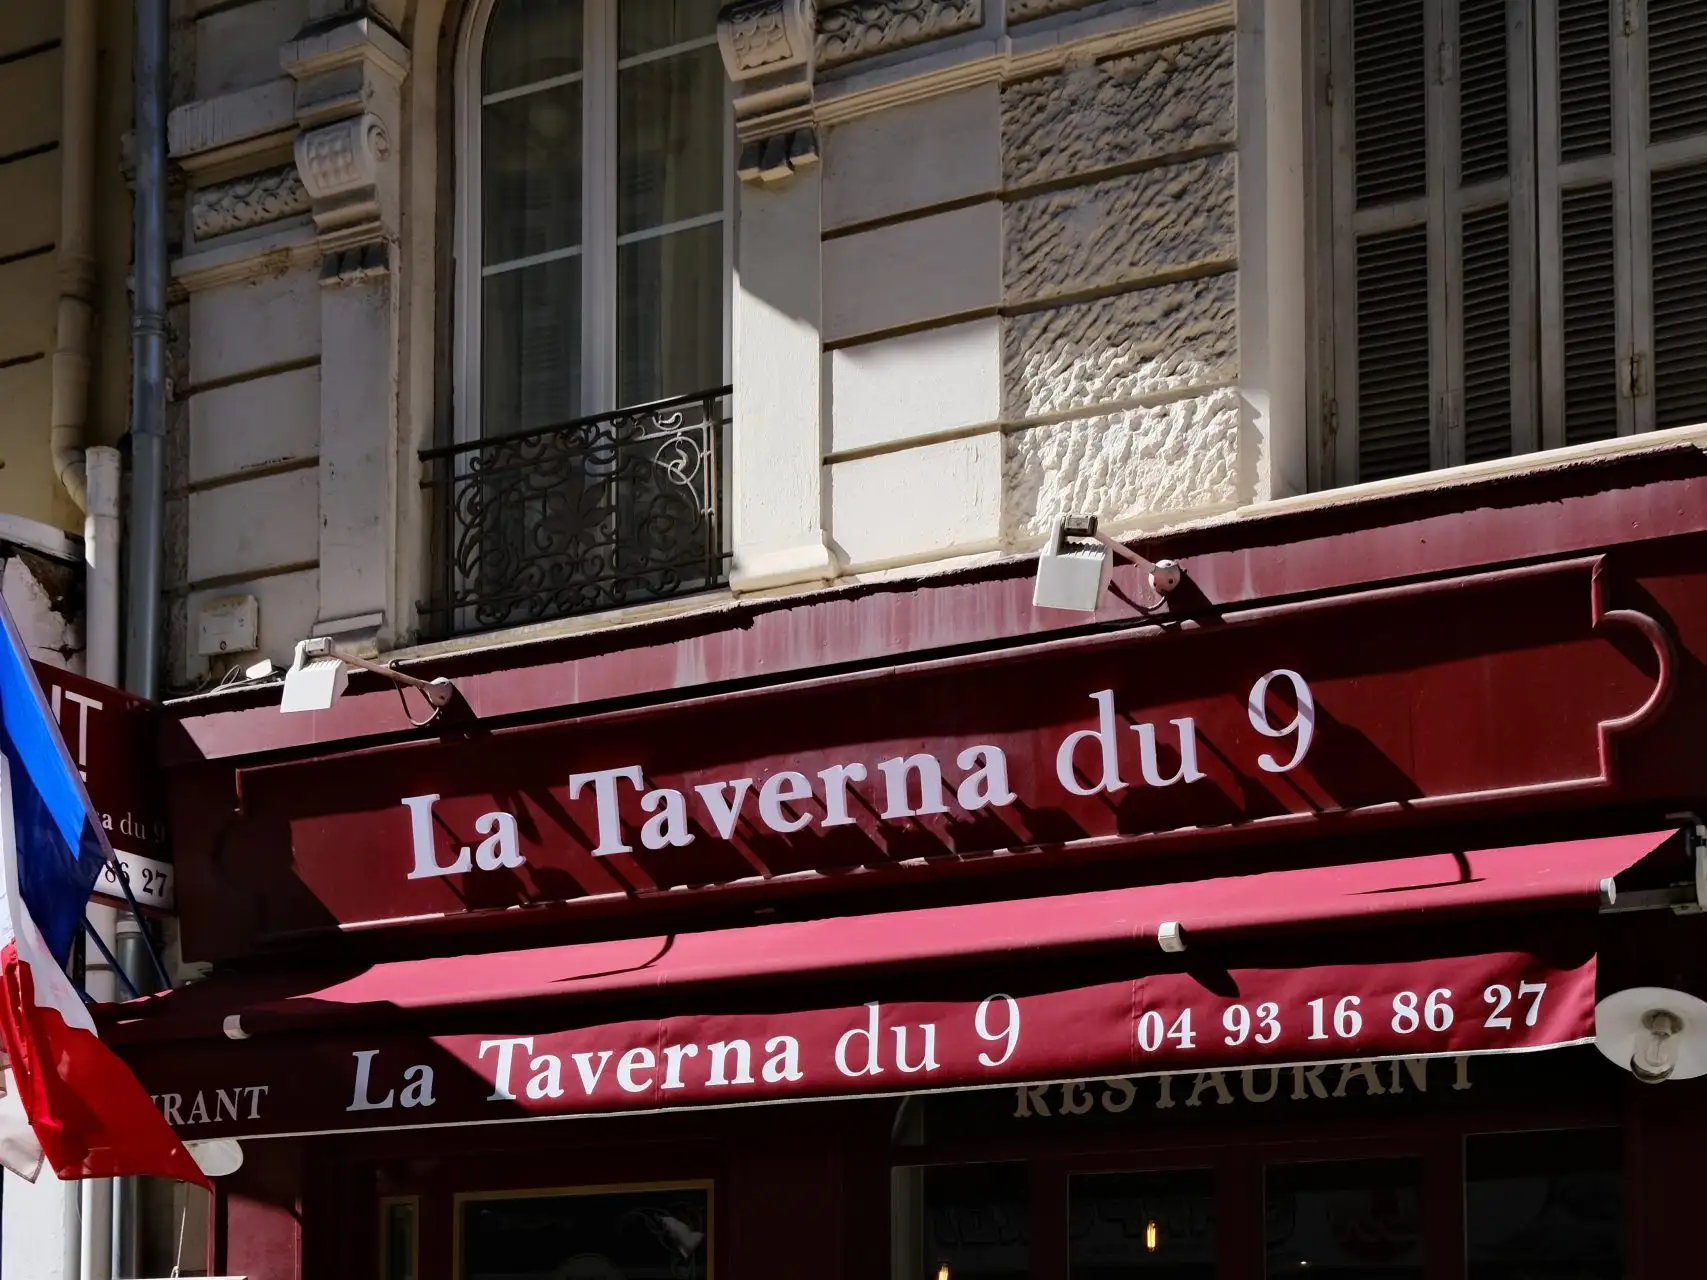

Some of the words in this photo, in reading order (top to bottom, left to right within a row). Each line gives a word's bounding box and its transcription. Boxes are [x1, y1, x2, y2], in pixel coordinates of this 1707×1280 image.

[401, 793, 526, 879] La
[569, 744, 1018, 857] Taverna
[1056, 689, 1207, 797] du
[1247, 668, 1315, 773] 9
[120, 811, 146, 840] du
[153, 821, 166, 844] 9
[142, 867, 168, 898] 27
[1137, 1008, 1196, 1052] 04
[1222, 1002, 1282, 1046] 93
[1307, 995, 1363, 1040] 16
[1391, 988, 1454, 1034] 86
[1483, 980, 1547, 1031] 27
[347, 1049, 436, 1112] La
[478, 1033, 804, 1102] Taverna
[834, 1002, 940, 1077] du
[974, 993, 1020, 1067] 9
